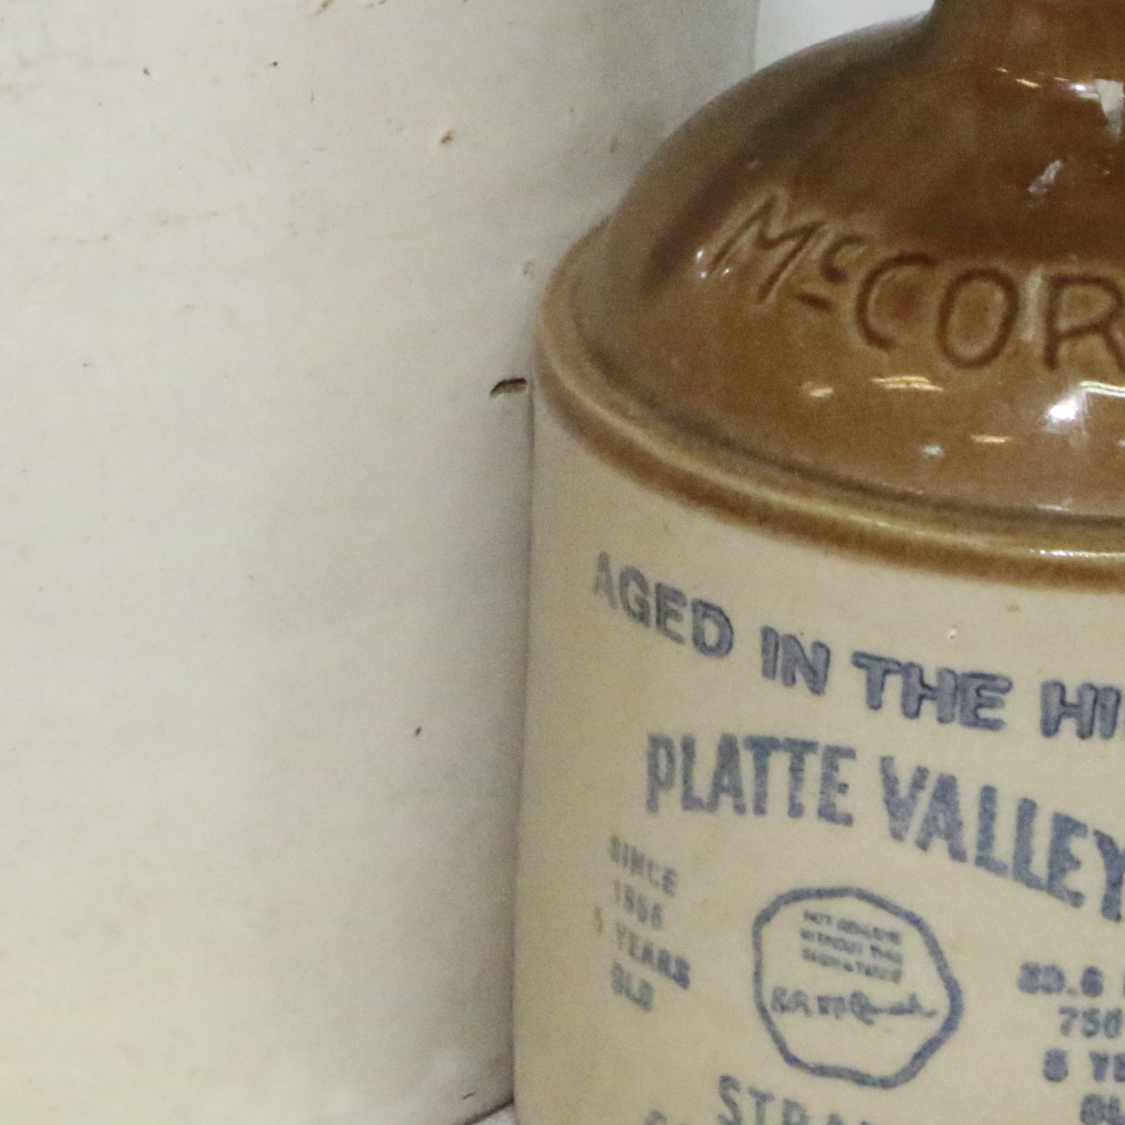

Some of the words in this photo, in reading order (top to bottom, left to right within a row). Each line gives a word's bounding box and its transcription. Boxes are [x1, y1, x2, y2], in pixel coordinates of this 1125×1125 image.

[591, 552, 735, 659] AGED
[760, 626, 831, 695] IN
[852, 650, 1014, 731] THE
[609, 834, 678, 897] SINCE
[646, 732, 857, 827] PLATTE
[879, 755, 1125, 923] VALLEY
[616, 922, 690, 990] YEARS
